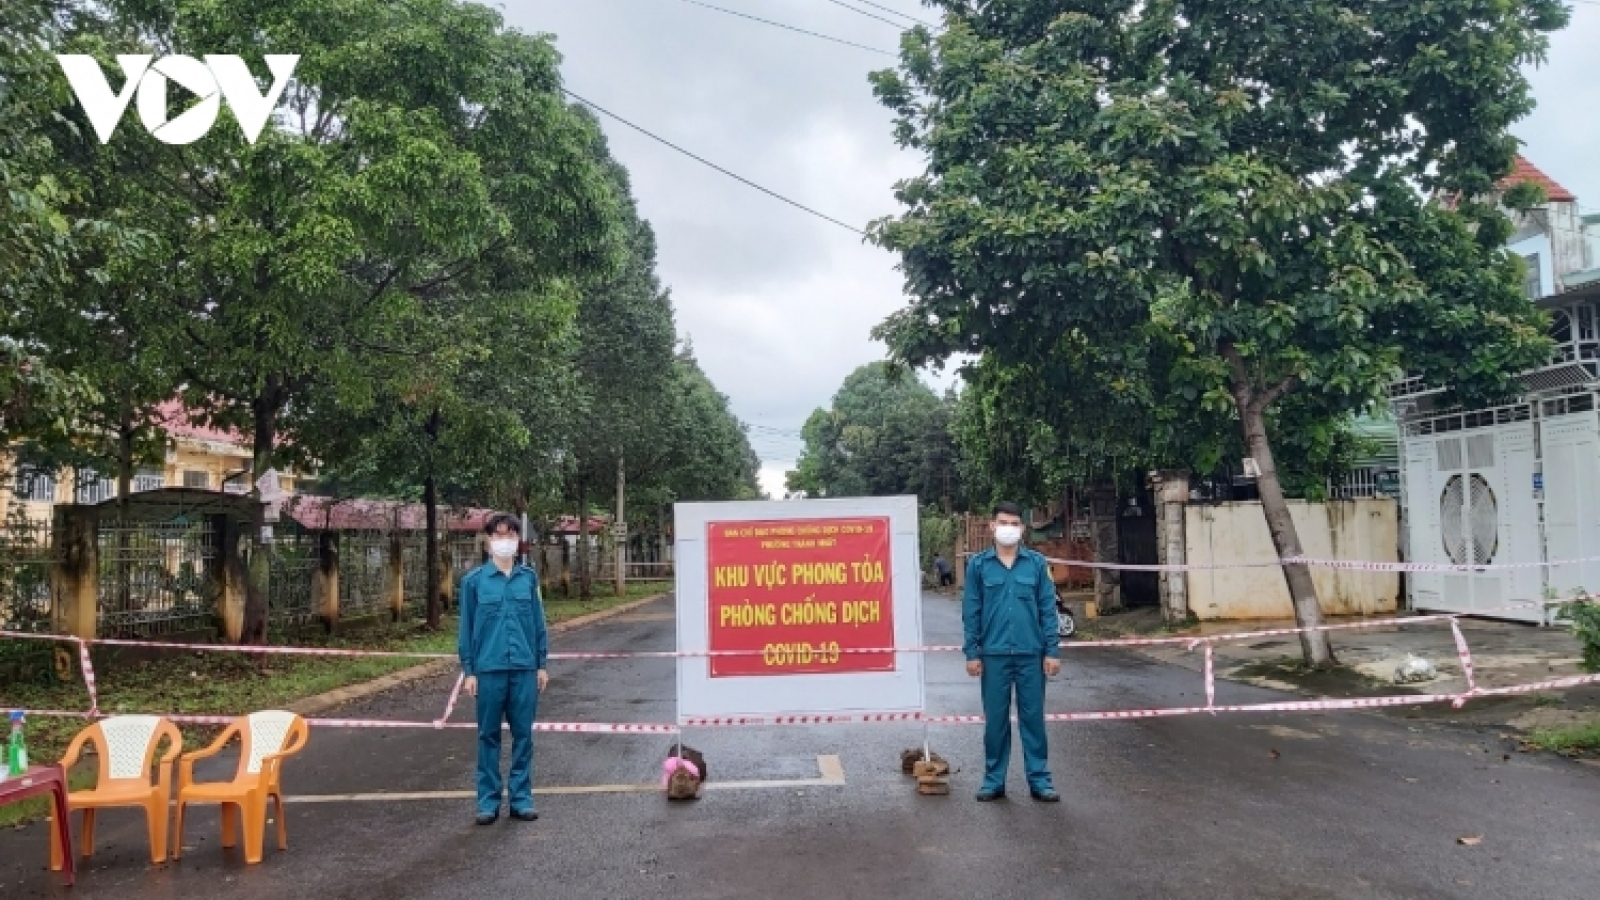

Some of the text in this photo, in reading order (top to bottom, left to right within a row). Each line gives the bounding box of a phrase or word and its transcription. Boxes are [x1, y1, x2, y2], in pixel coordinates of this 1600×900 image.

[714, 553, 884, 590] KHU VỰC PHONG TỎA
[720, 593, 880, 629] PHÒNG CHỐNG DỊCH
[763, 641, 840, 666] COVID-19
